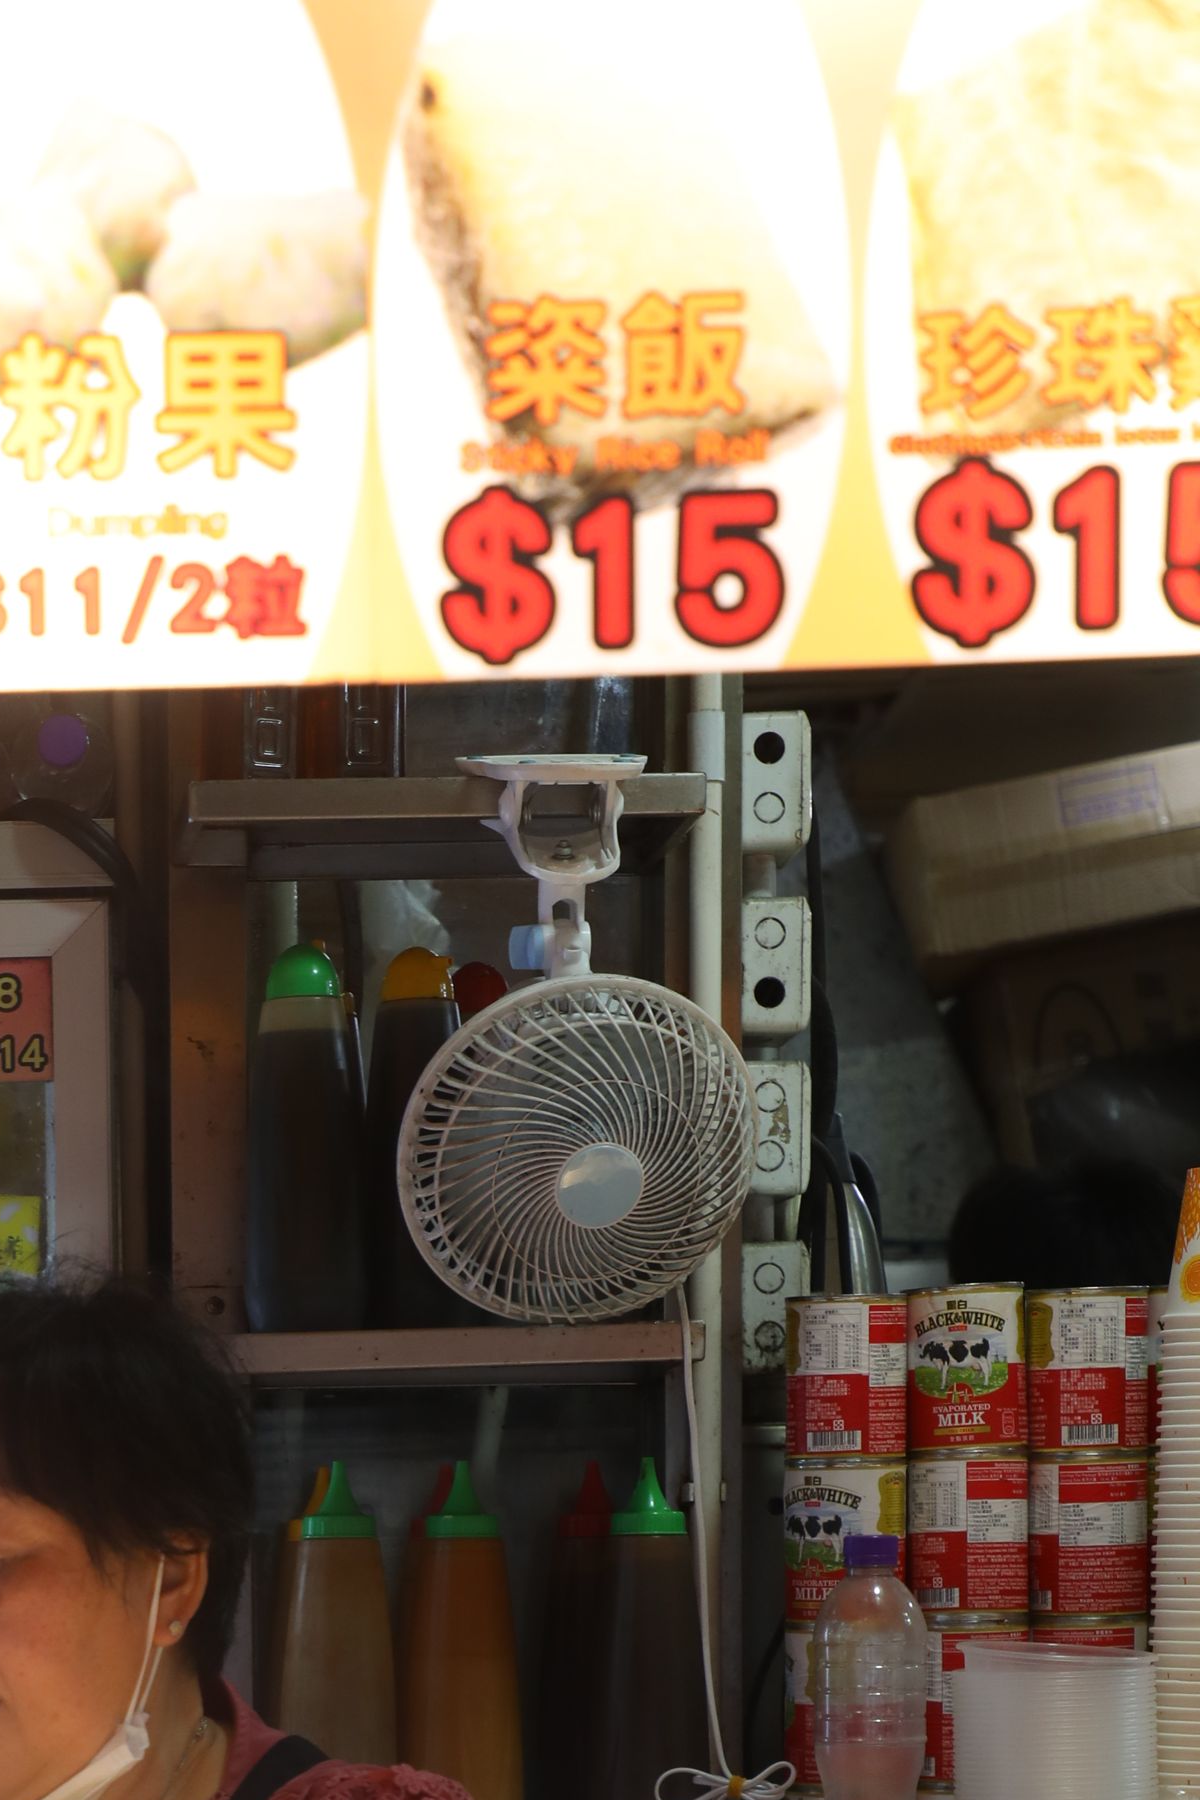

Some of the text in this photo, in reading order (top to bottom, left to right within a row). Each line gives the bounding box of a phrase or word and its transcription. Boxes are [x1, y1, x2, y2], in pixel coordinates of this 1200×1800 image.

[0, 328, 300, 482] 粉果
[917, 296, 1200, 421] 珍珠
[47, 503, 228, 539] Dumpling
[439, 484, 787, 668] $15
[937, 1412, 986, 1427] MILK
